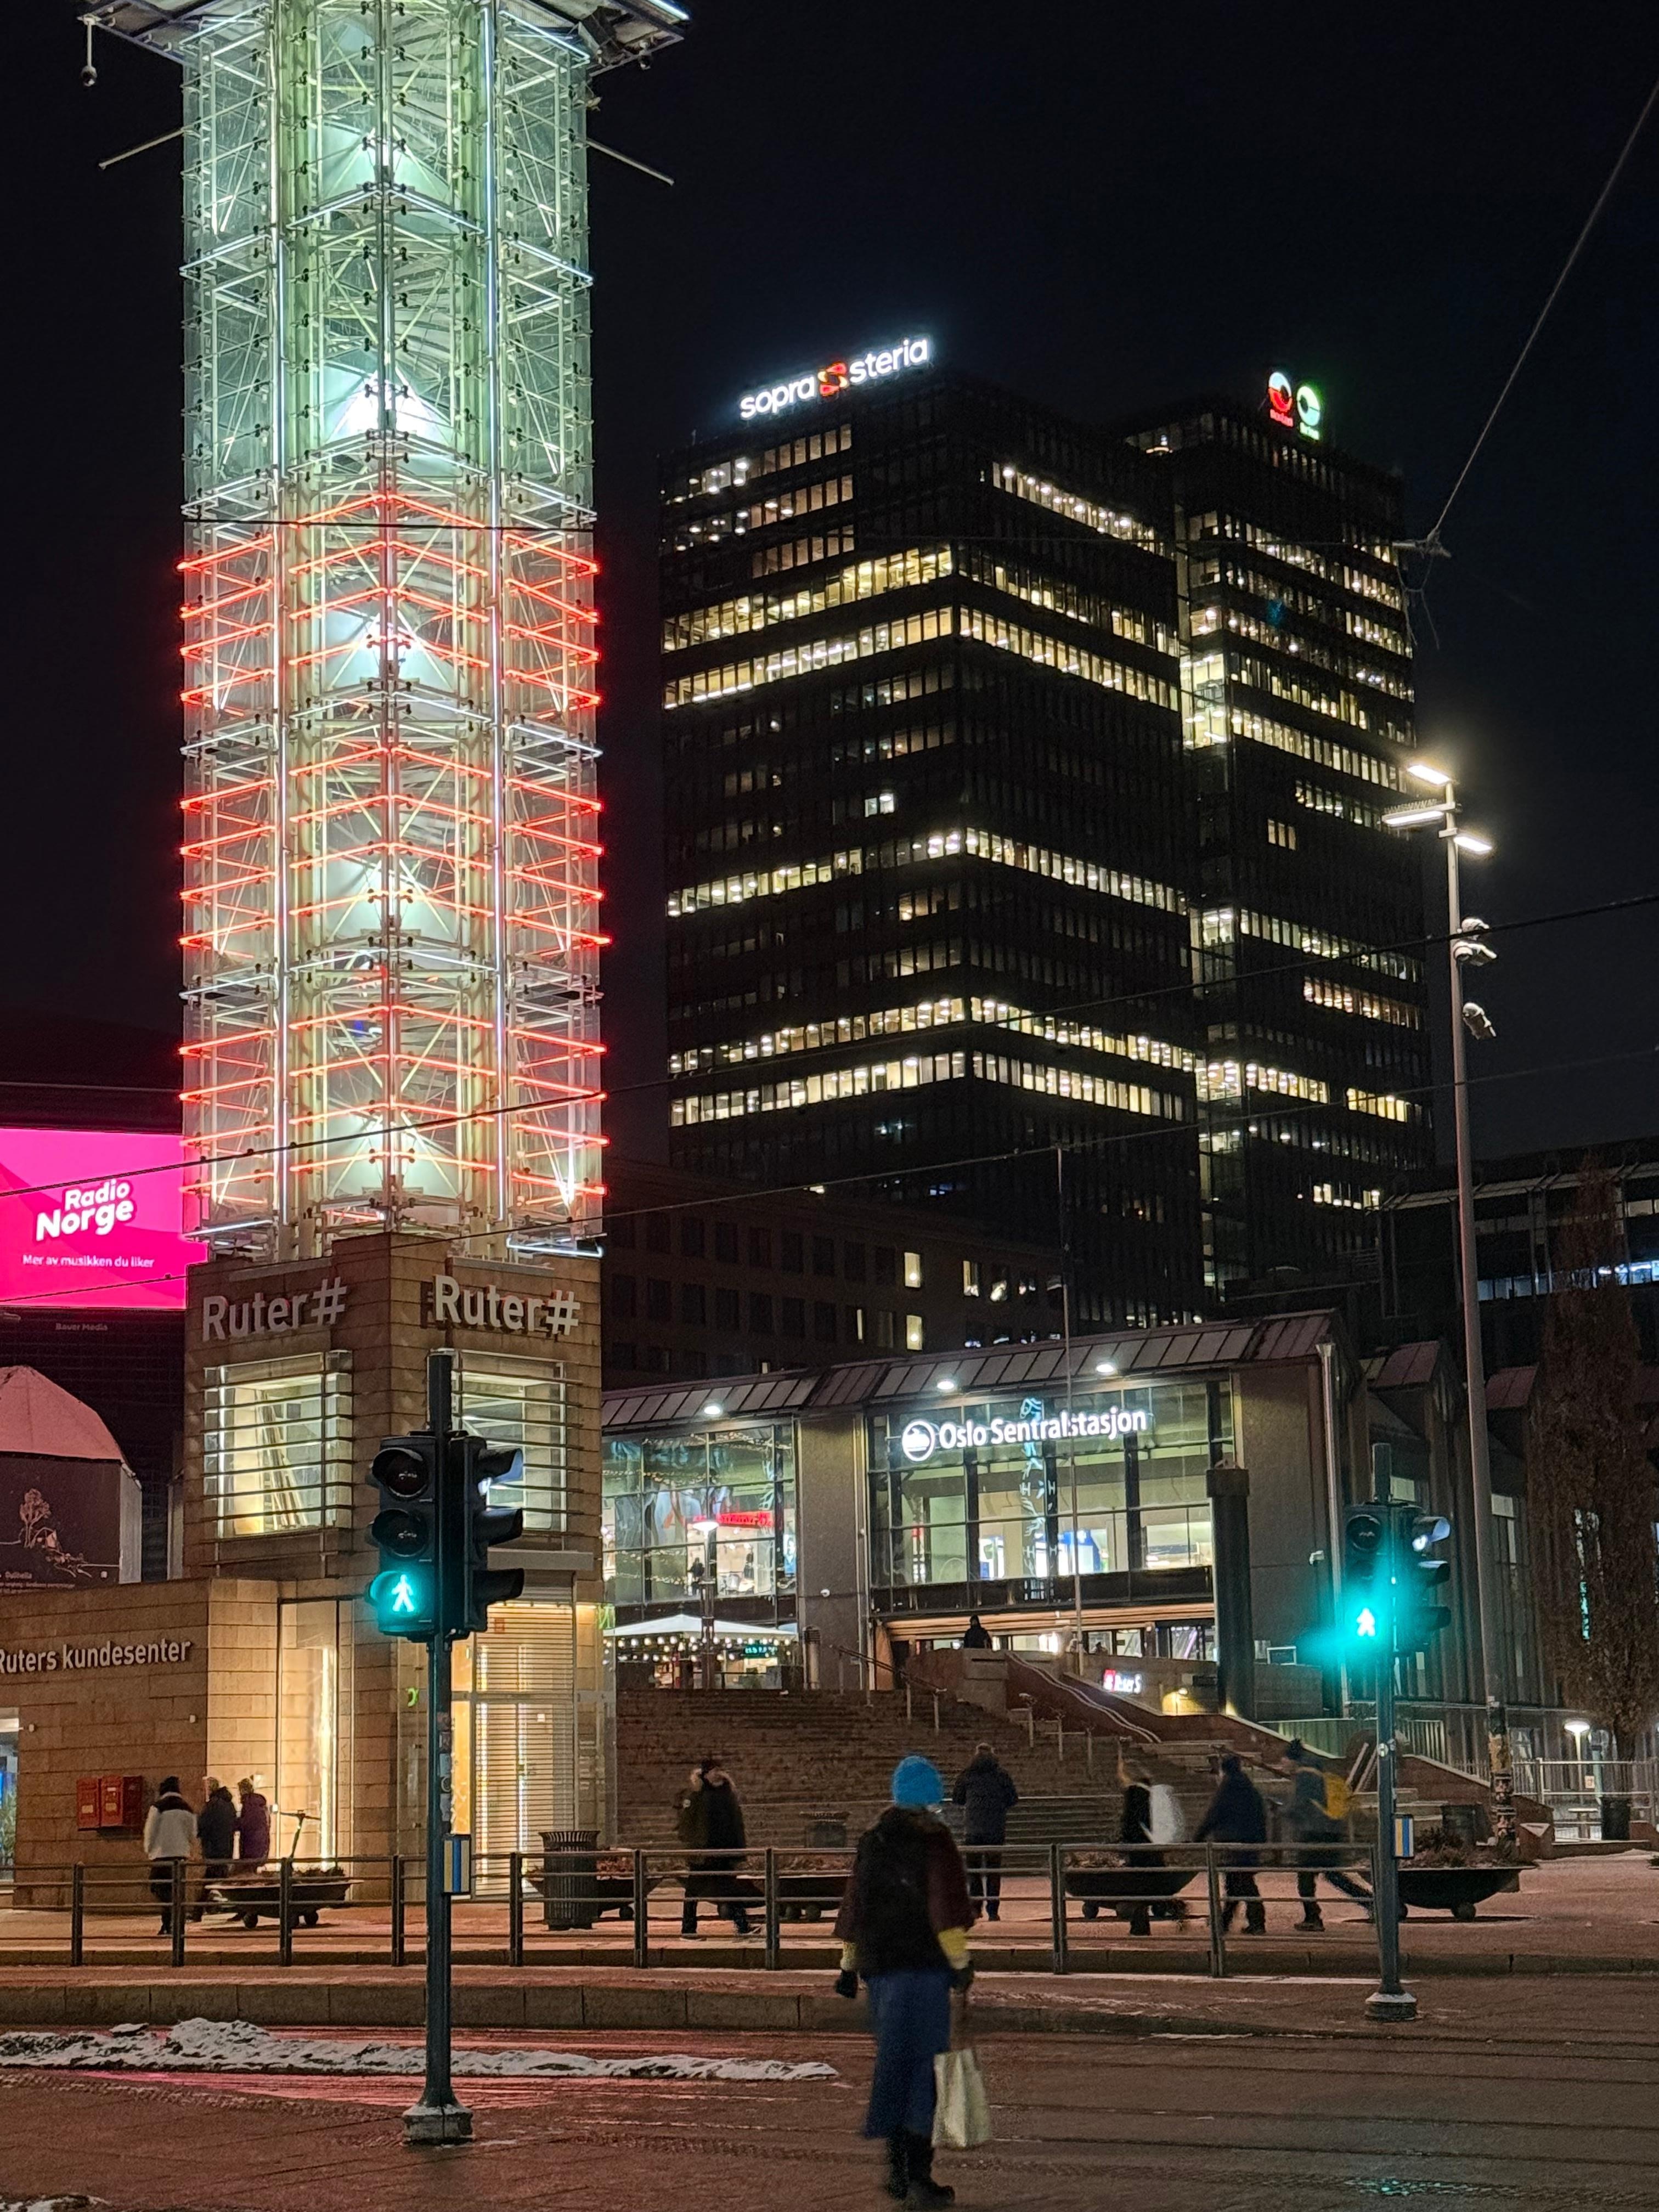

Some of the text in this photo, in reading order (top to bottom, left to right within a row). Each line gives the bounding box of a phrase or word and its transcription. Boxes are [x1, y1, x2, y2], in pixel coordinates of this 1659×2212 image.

[740, 337, 928, 419] sopra steria
[64, 1179, 131, 1211] Radio
[36, 1200, 134, 1242] Norge
[22, 1254, 155, 1268] Mer av musikken du liker
[202, 1277, 348, 1342] Ruter#
[433, 1273, 581, 1336] Ruter#
[939, 1405, 1147, 1449] Oslo Sentralstasjon
[63, 1638, 191, 1669] kundesenter
